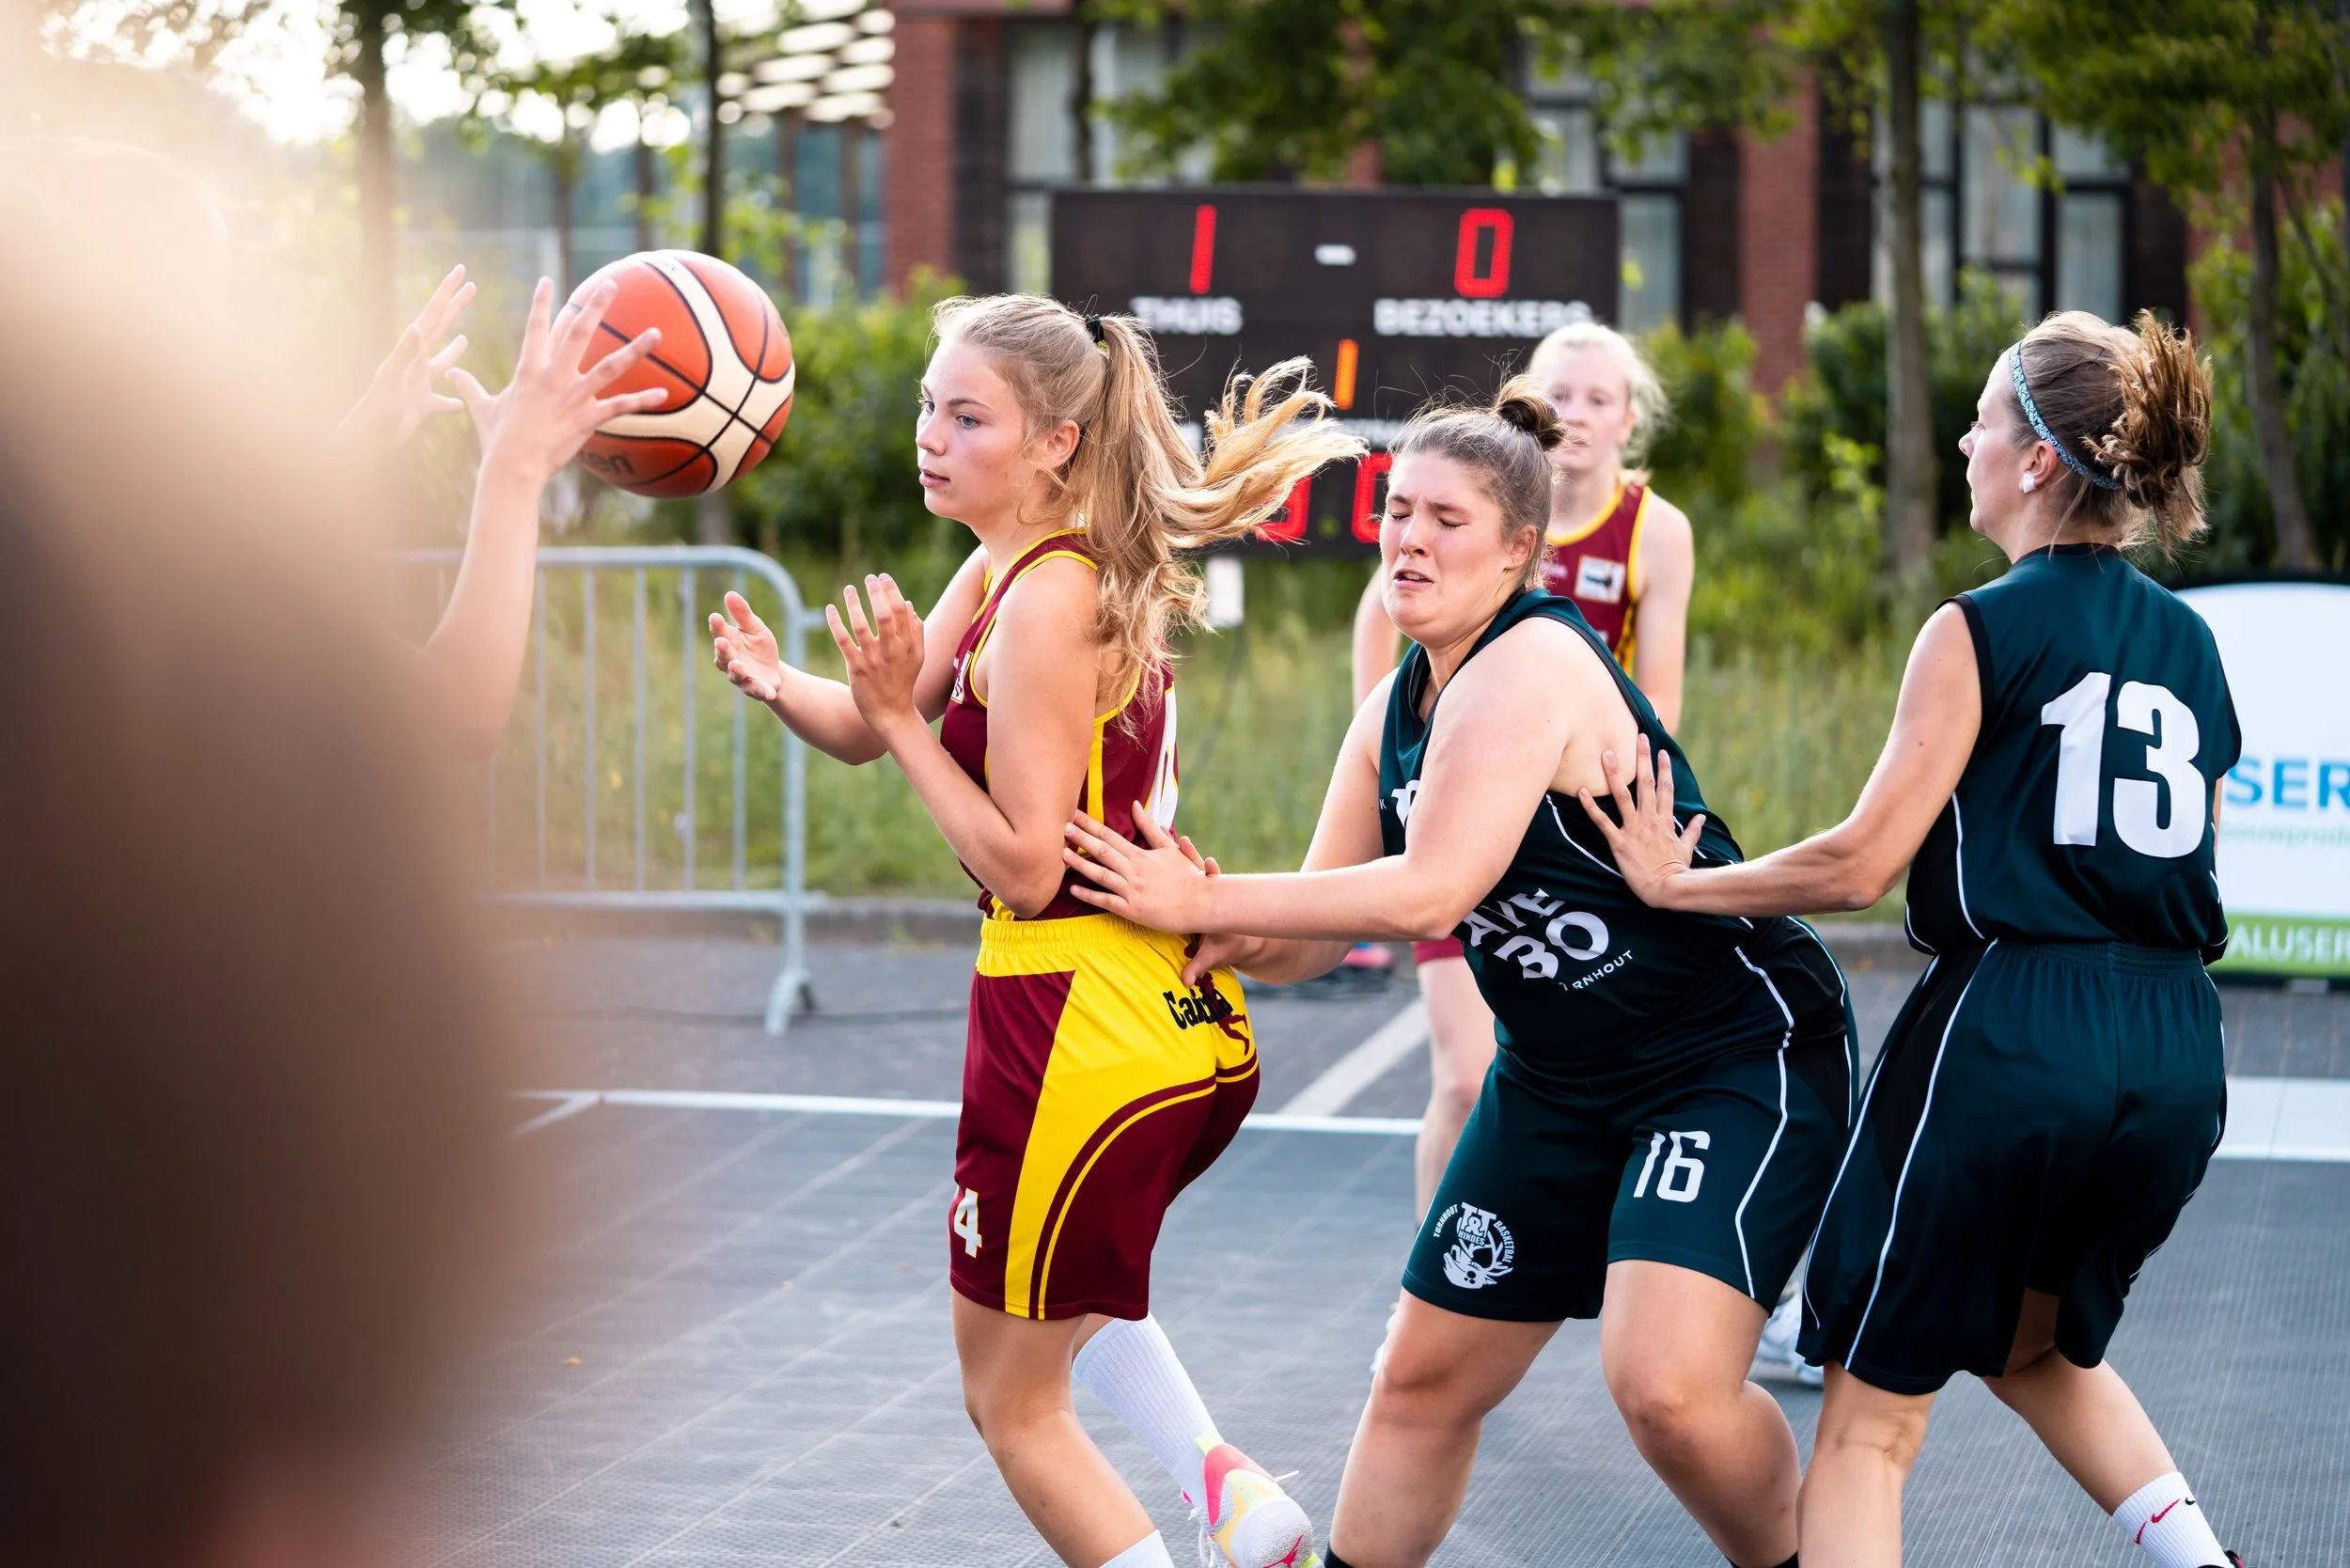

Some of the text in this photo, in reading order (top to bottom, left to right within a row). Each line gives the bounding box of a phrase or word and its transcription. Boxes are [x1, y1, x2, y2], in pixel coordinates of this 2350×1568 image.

[1190, 204, 1216, 294] 1
[1454, 208, 1514, 298] 0
[1131, 296, 1243, 336] THUIS
[1373, 298, 1592, 337] BEZOEKERS
[1334, 338, 1358, 410] 1
[2041, 672, 2206, 858] 13
[1494, 911, 1609, 980] 30
[1559, 949, 1633, 992] TRNHOUT
[1634, 1131, 1711, 1203] 16
[954, 1187, 982, 1259] 4
[1433, 1203, 1459, 1238] TURNHOUT
[1458, 1230, 1485, 1247] HINDES
[1493, 1220, 1515, 1263] BASKETBAL
